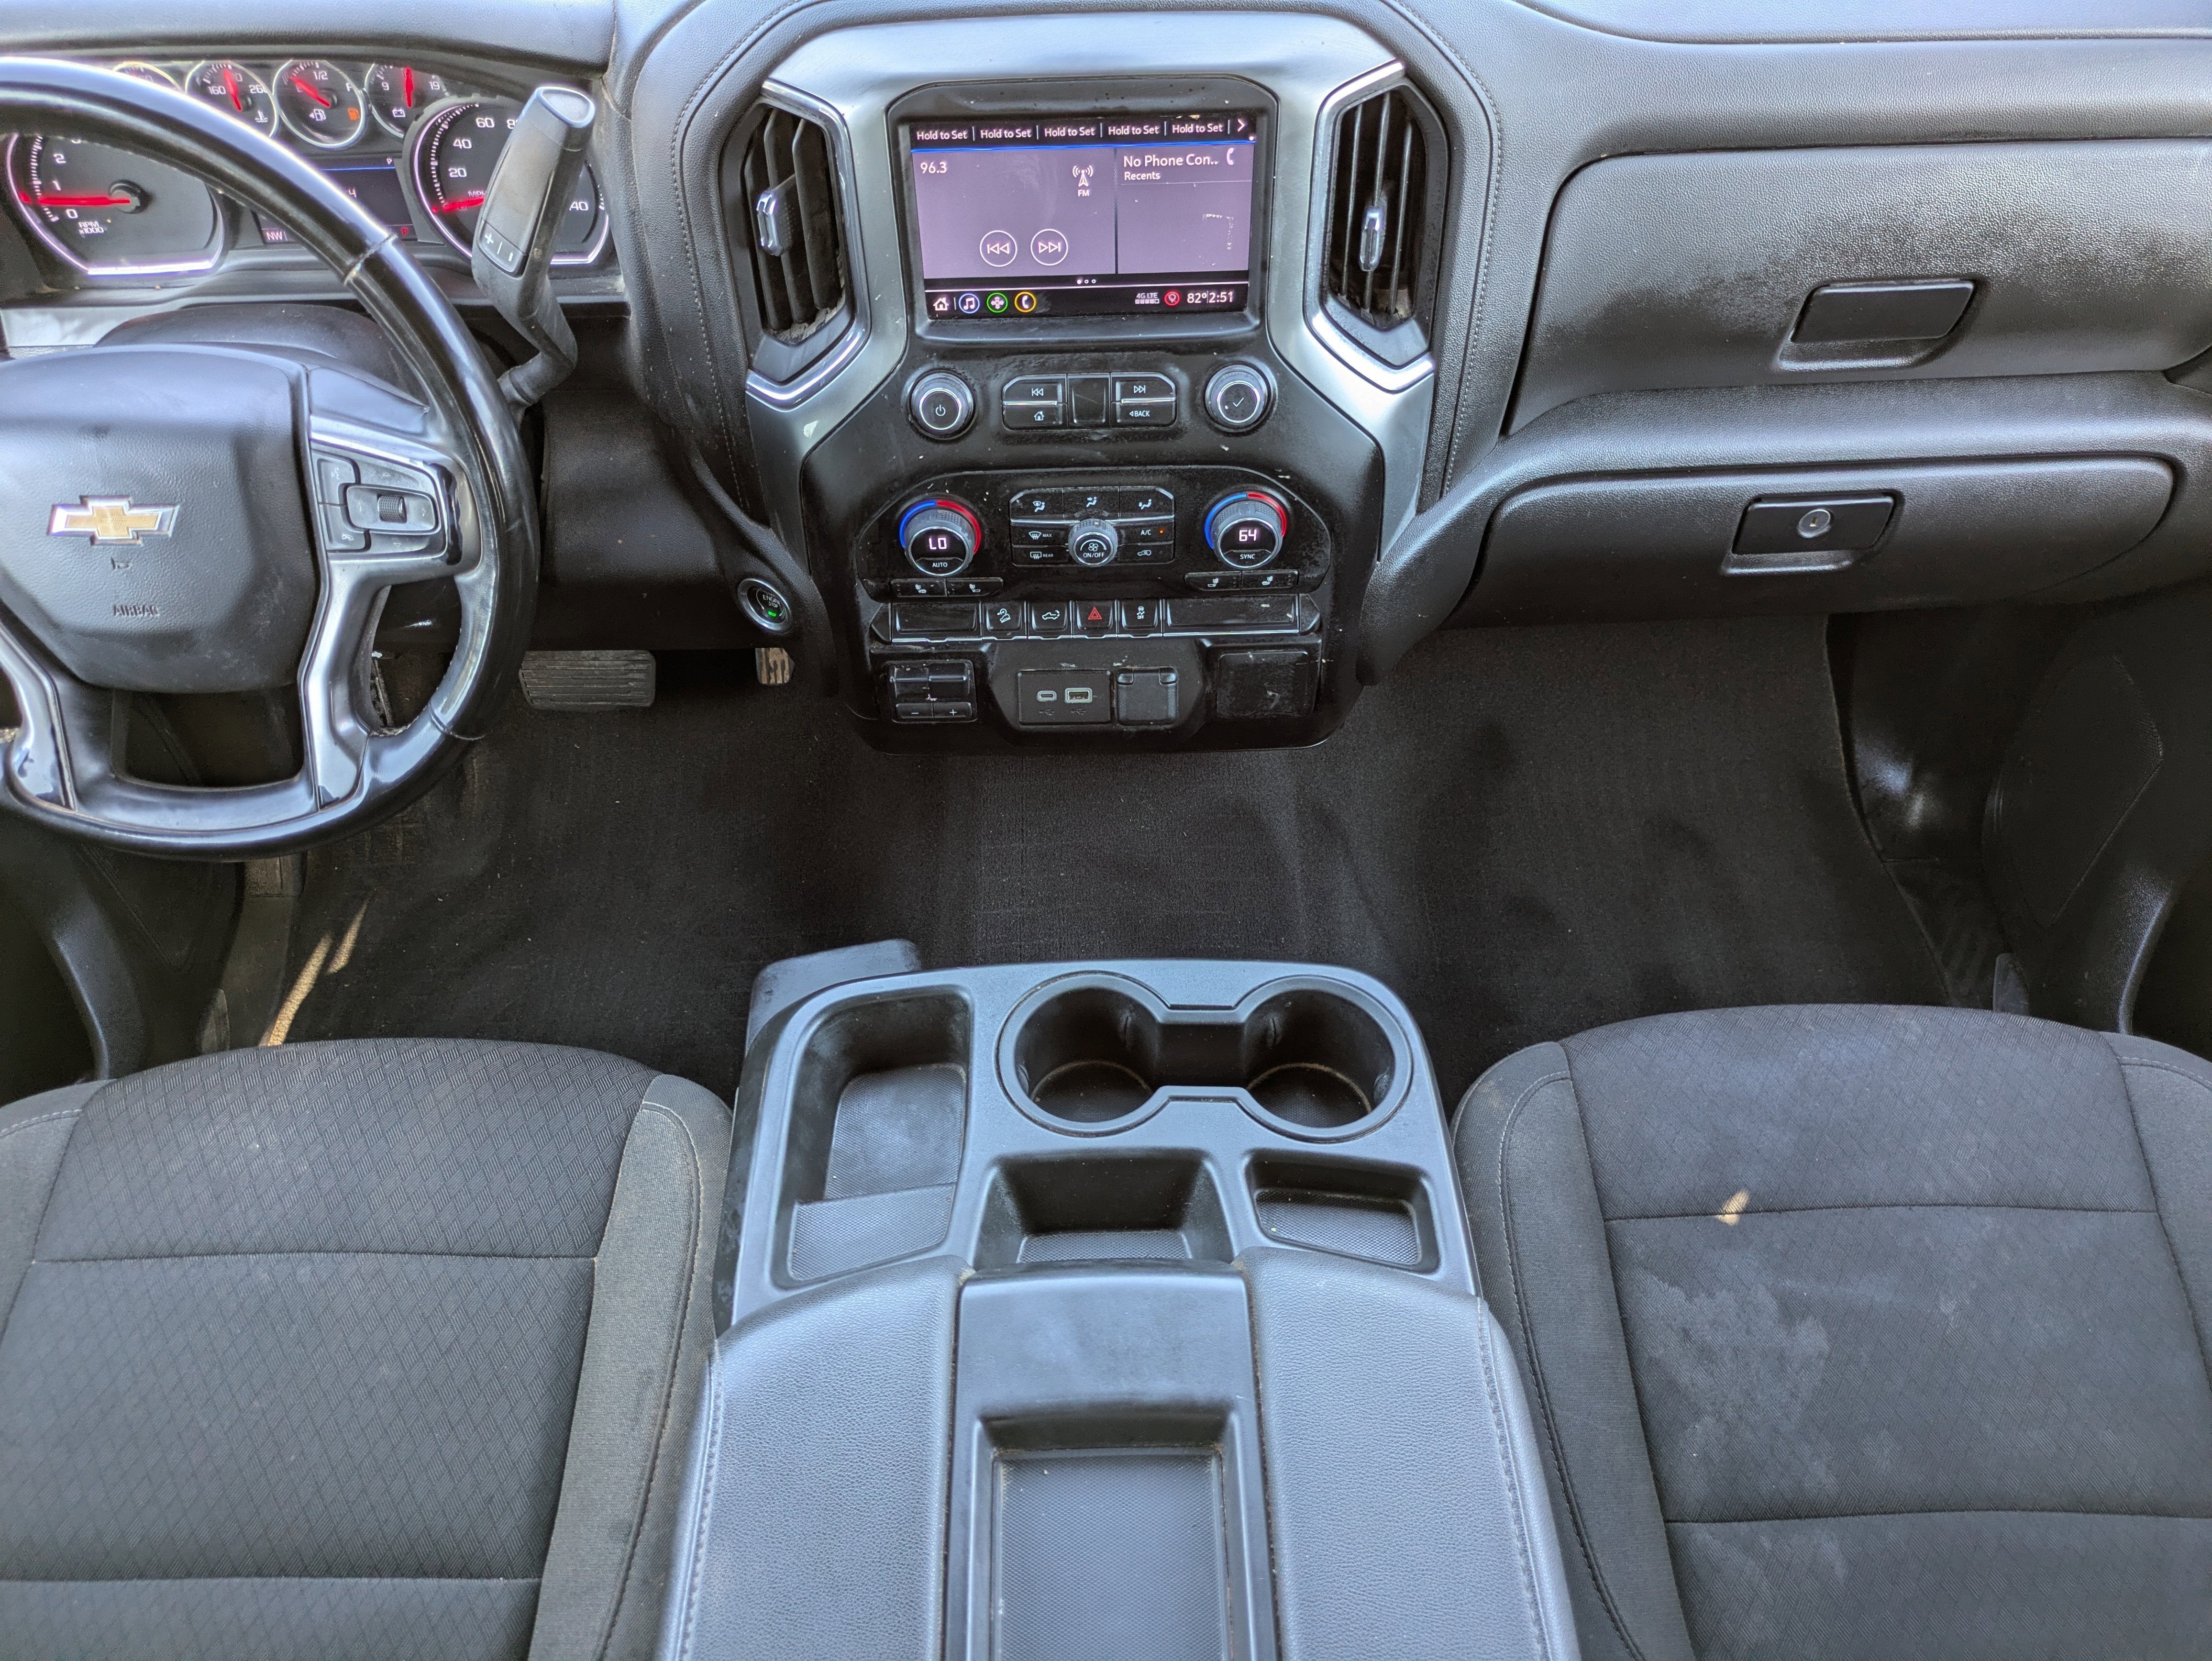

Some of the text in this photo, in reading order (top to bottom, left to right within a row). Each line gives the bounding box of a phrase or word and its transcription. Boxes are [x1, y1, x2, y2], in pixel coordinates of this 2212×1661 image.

[313, 70, 328, 80] 1/2
[208, 86, 226, 95] 160
[381, 81, 389, 90] 9
[429, 81, 440, 90] 19
[476, 117, 495, 128] 60
[507, 119, 518, 129] 8
[1044, 127, 1095, 137] Hold to Set
[1108, 125, 1160, 135] Hold to Set
[1172, 123, 1224, 133] Hold to Set
[917, 130, 938, 140] Hold
[951, 130, 968, 139] Set
[981, 129, 1032, 139] Hold to Set
[453, 139, 472, 149] 40
[53, 153, 66, 164] 2
[1124, 154, 1219, 167] No Phone Con..
[448, 167, 467, 177] 20
[920, 162, 947, 174] 96.3
[1124, 171, 1161, 181] Recents
[52, 180, 62, 191] 1
[66, 208, 78, 219] 0
[266, 232, 282, 240] NW
[1208, 291, 1233, 303] 2:51
[1239, 529, 1257, 542] 64
[929, 538, 947, 550] LO
[113, 604, 158, 616] AIRBAG
